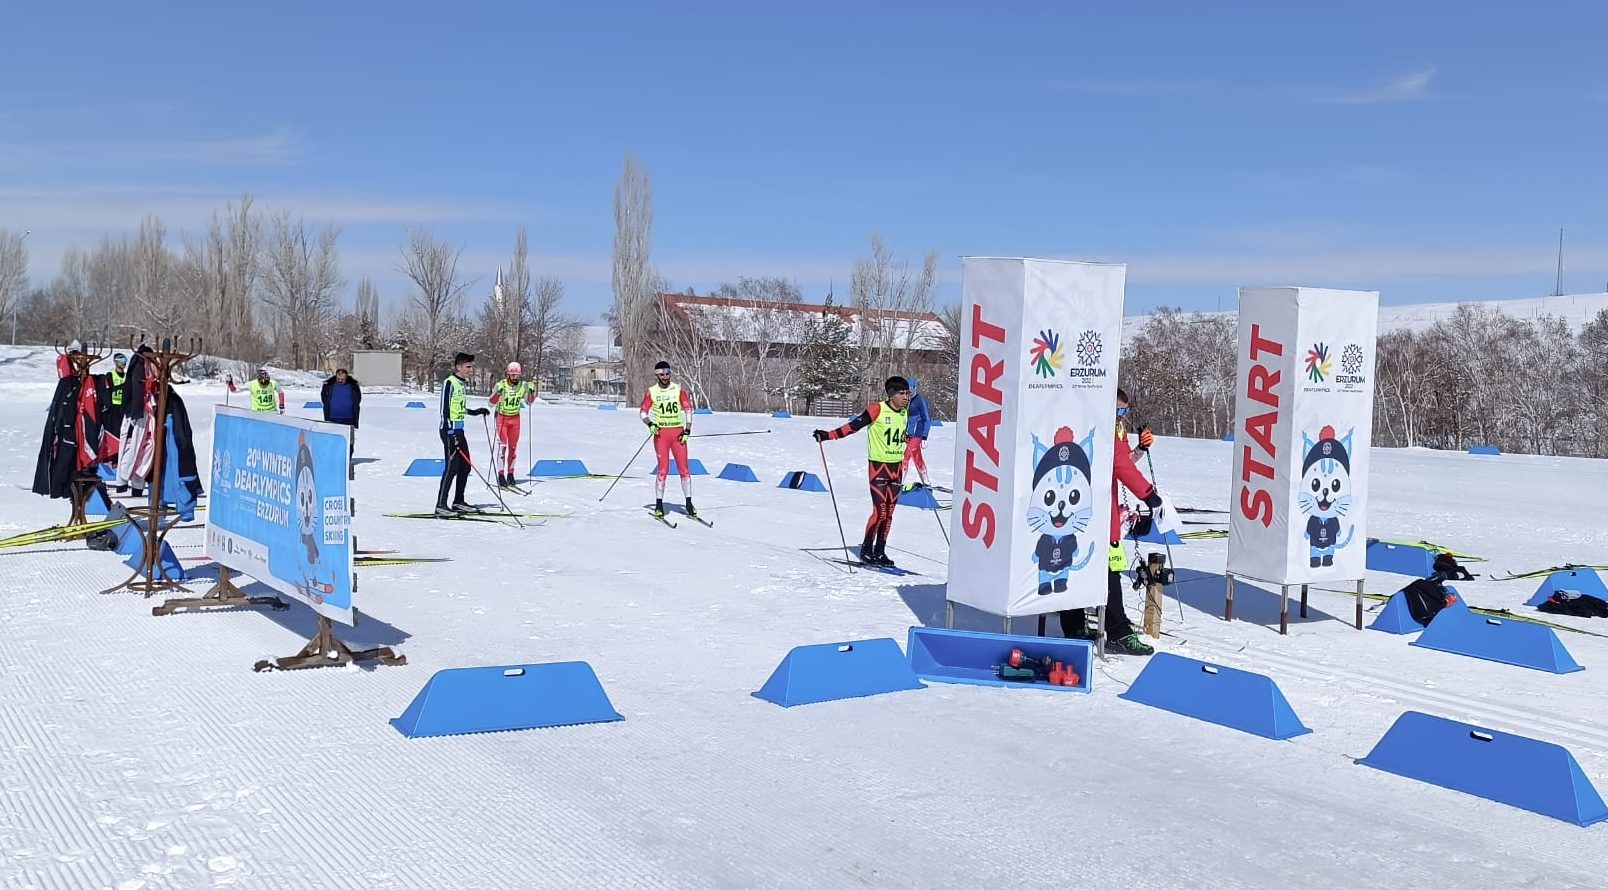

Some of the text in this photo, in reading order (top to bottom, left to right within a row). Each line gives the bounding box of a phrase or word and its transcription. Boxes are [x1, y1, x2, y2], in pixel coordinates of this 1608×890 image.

[1070, 368, 1106, 377] ERZURUM
[1335, 375, 1365, 384] ERZURUM
[257, 395, 273, 403] 149
[659, 401, 679, 414] 146
[962, 304, 1006, 549] START
[1240, 324, 1282, 528] START
[261, 450, 292, 478] WINTER
[234, 468, 291, 506] DEAFLYMPICS
[256, 499, 289, 528] ERZURUM
[324, 500, 343, 511] CROSS
